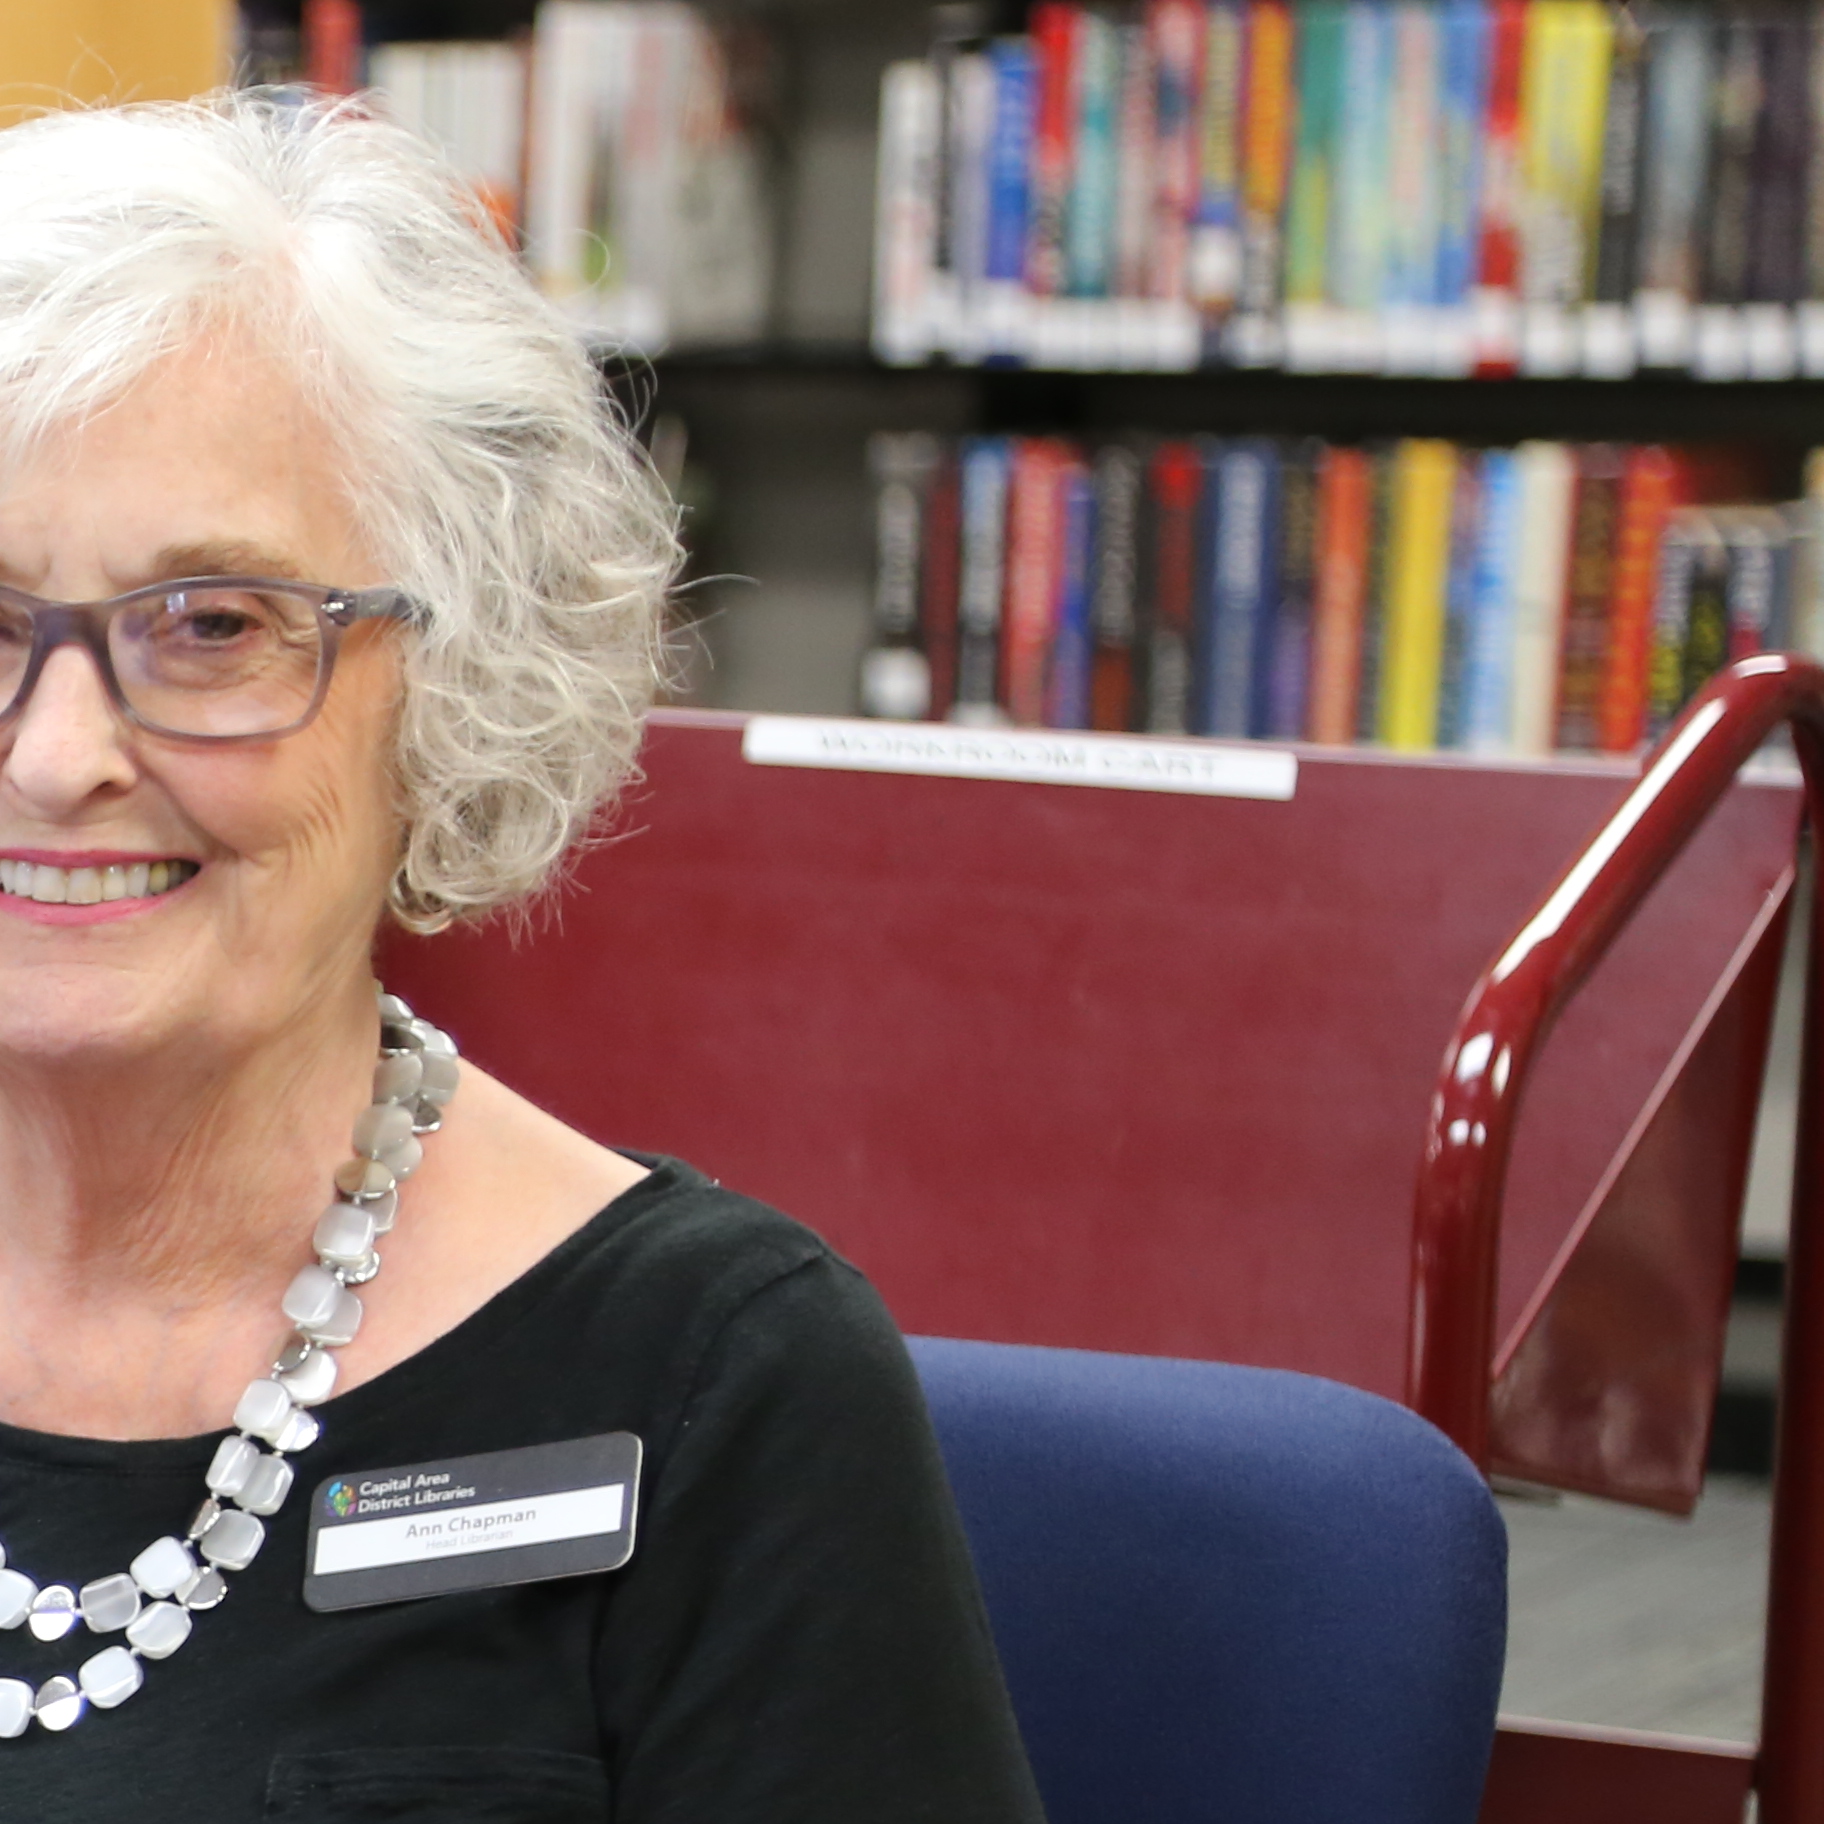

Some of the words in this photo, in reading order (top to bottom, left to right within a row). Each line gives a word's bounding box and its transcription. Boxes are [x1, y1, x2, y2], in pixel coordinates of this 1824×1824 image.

[819, 726, 1087, 771] WORKROOM
[1101, 746, 1220, 780] CART
[357, 1494, 411, 1514] District
[414, 1484, 477, 1506] Libraries
[359, 1474, 412, 1497] Capital
[414, 1471, 452, 1488] Area
[404, 1522, 443, 1540] Ann
[447, 1508, 537, 1533] Chapman
[425, 1536, 458, 1551] Head
[460, 1529, 514, 1548] Librarian
